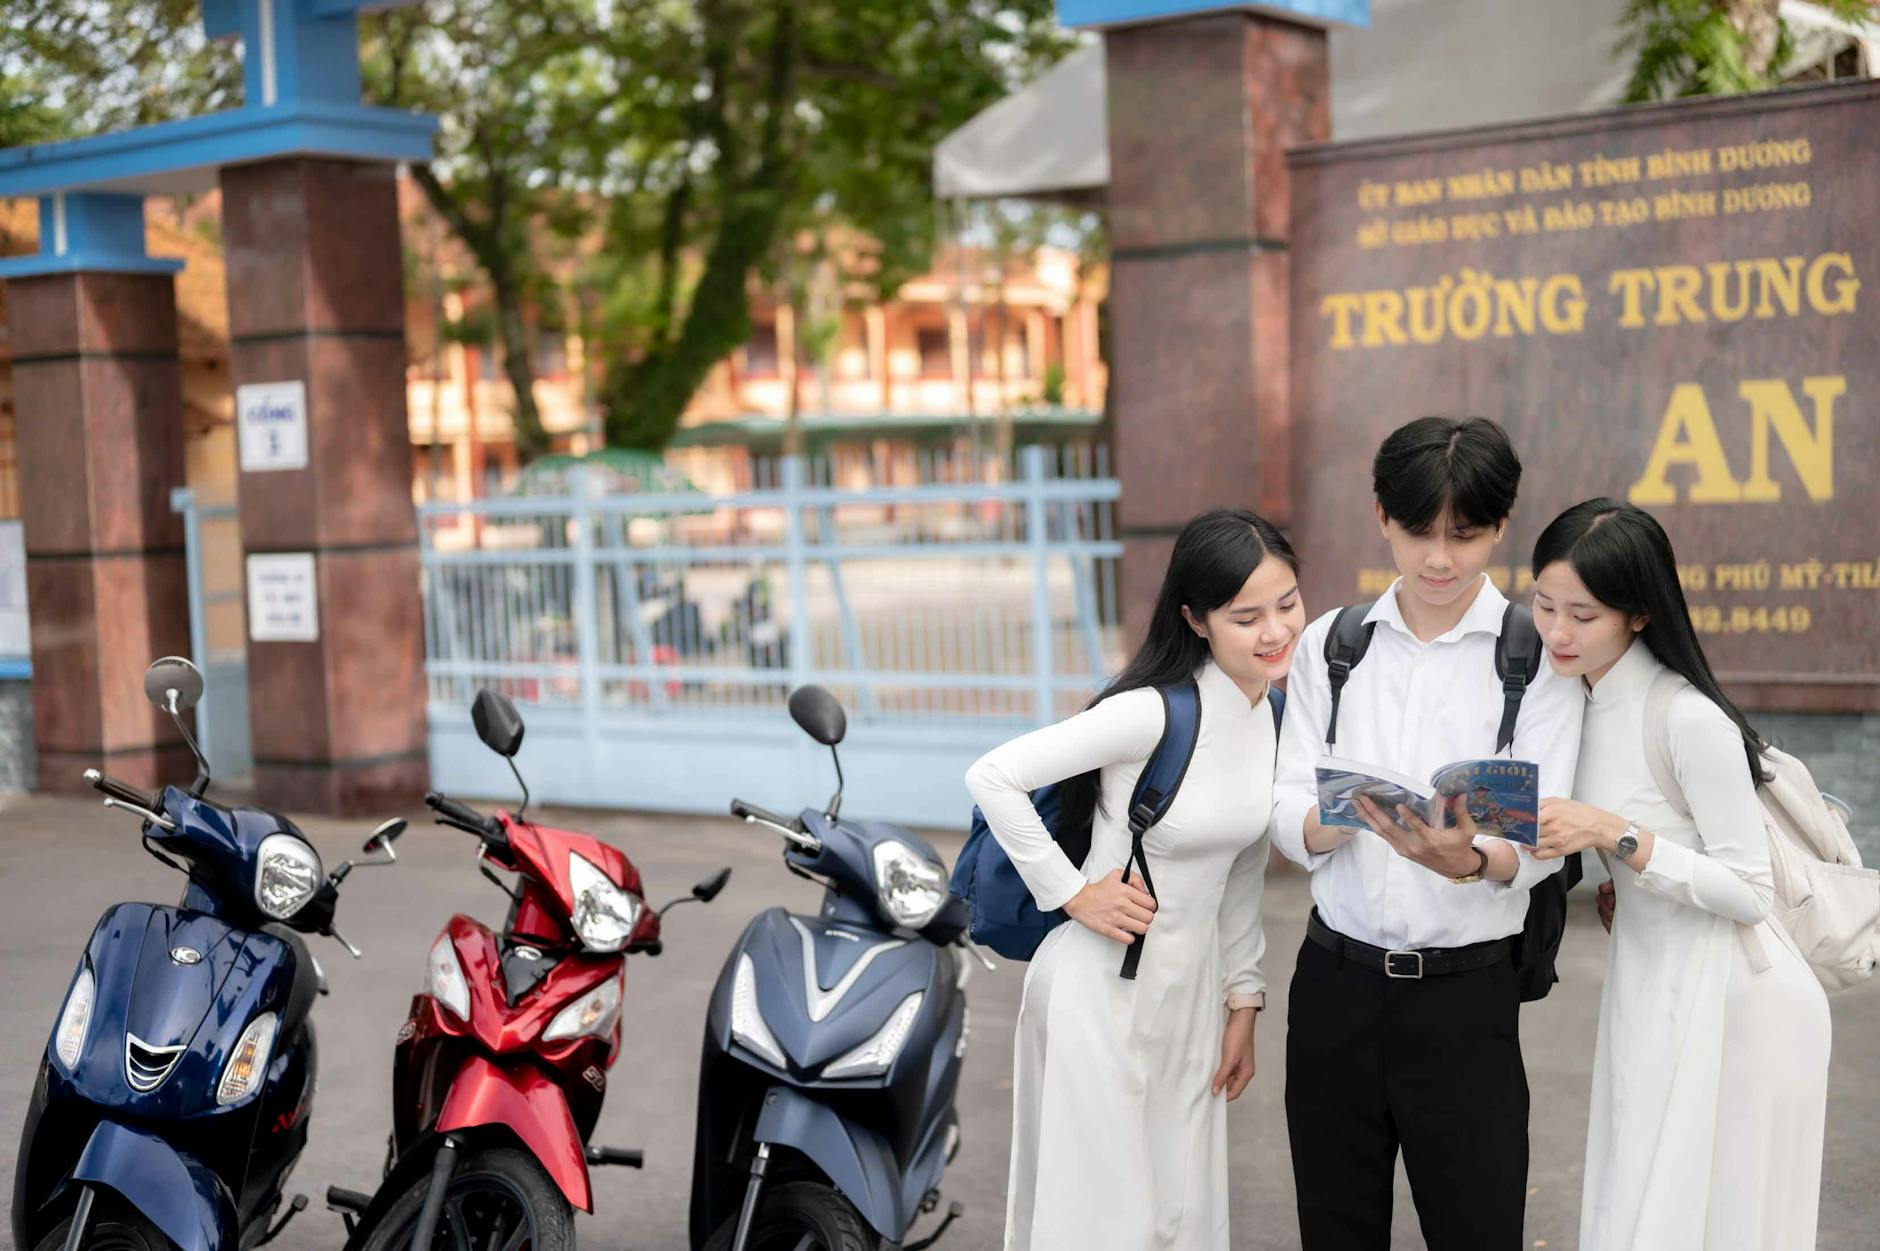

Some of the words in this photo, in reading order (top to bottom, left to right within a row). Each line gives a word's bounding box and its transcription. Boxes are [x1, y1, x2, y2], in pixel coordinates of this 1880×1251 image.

[1394, 179, 1442, 207] BAN
[1647, 147, 1711, 180] BÌNH
[1718, 138, 1811, 172] DƯƠNG
[1504, 202, 1538, 235] VÀ
[1600, 197, 1649, 229] TẠO
[1654, 189, 1716, 222] BÌNH
[1723, 181, 1811, 215] DƯƠNG
[1322, 267, 1587, 349] TRƯỜNG
[1609, 252, 1861, 329] TRUNG
[1629, 376, 1846, 503] AN
[1714, 559, 1771, 591] PHÚ
